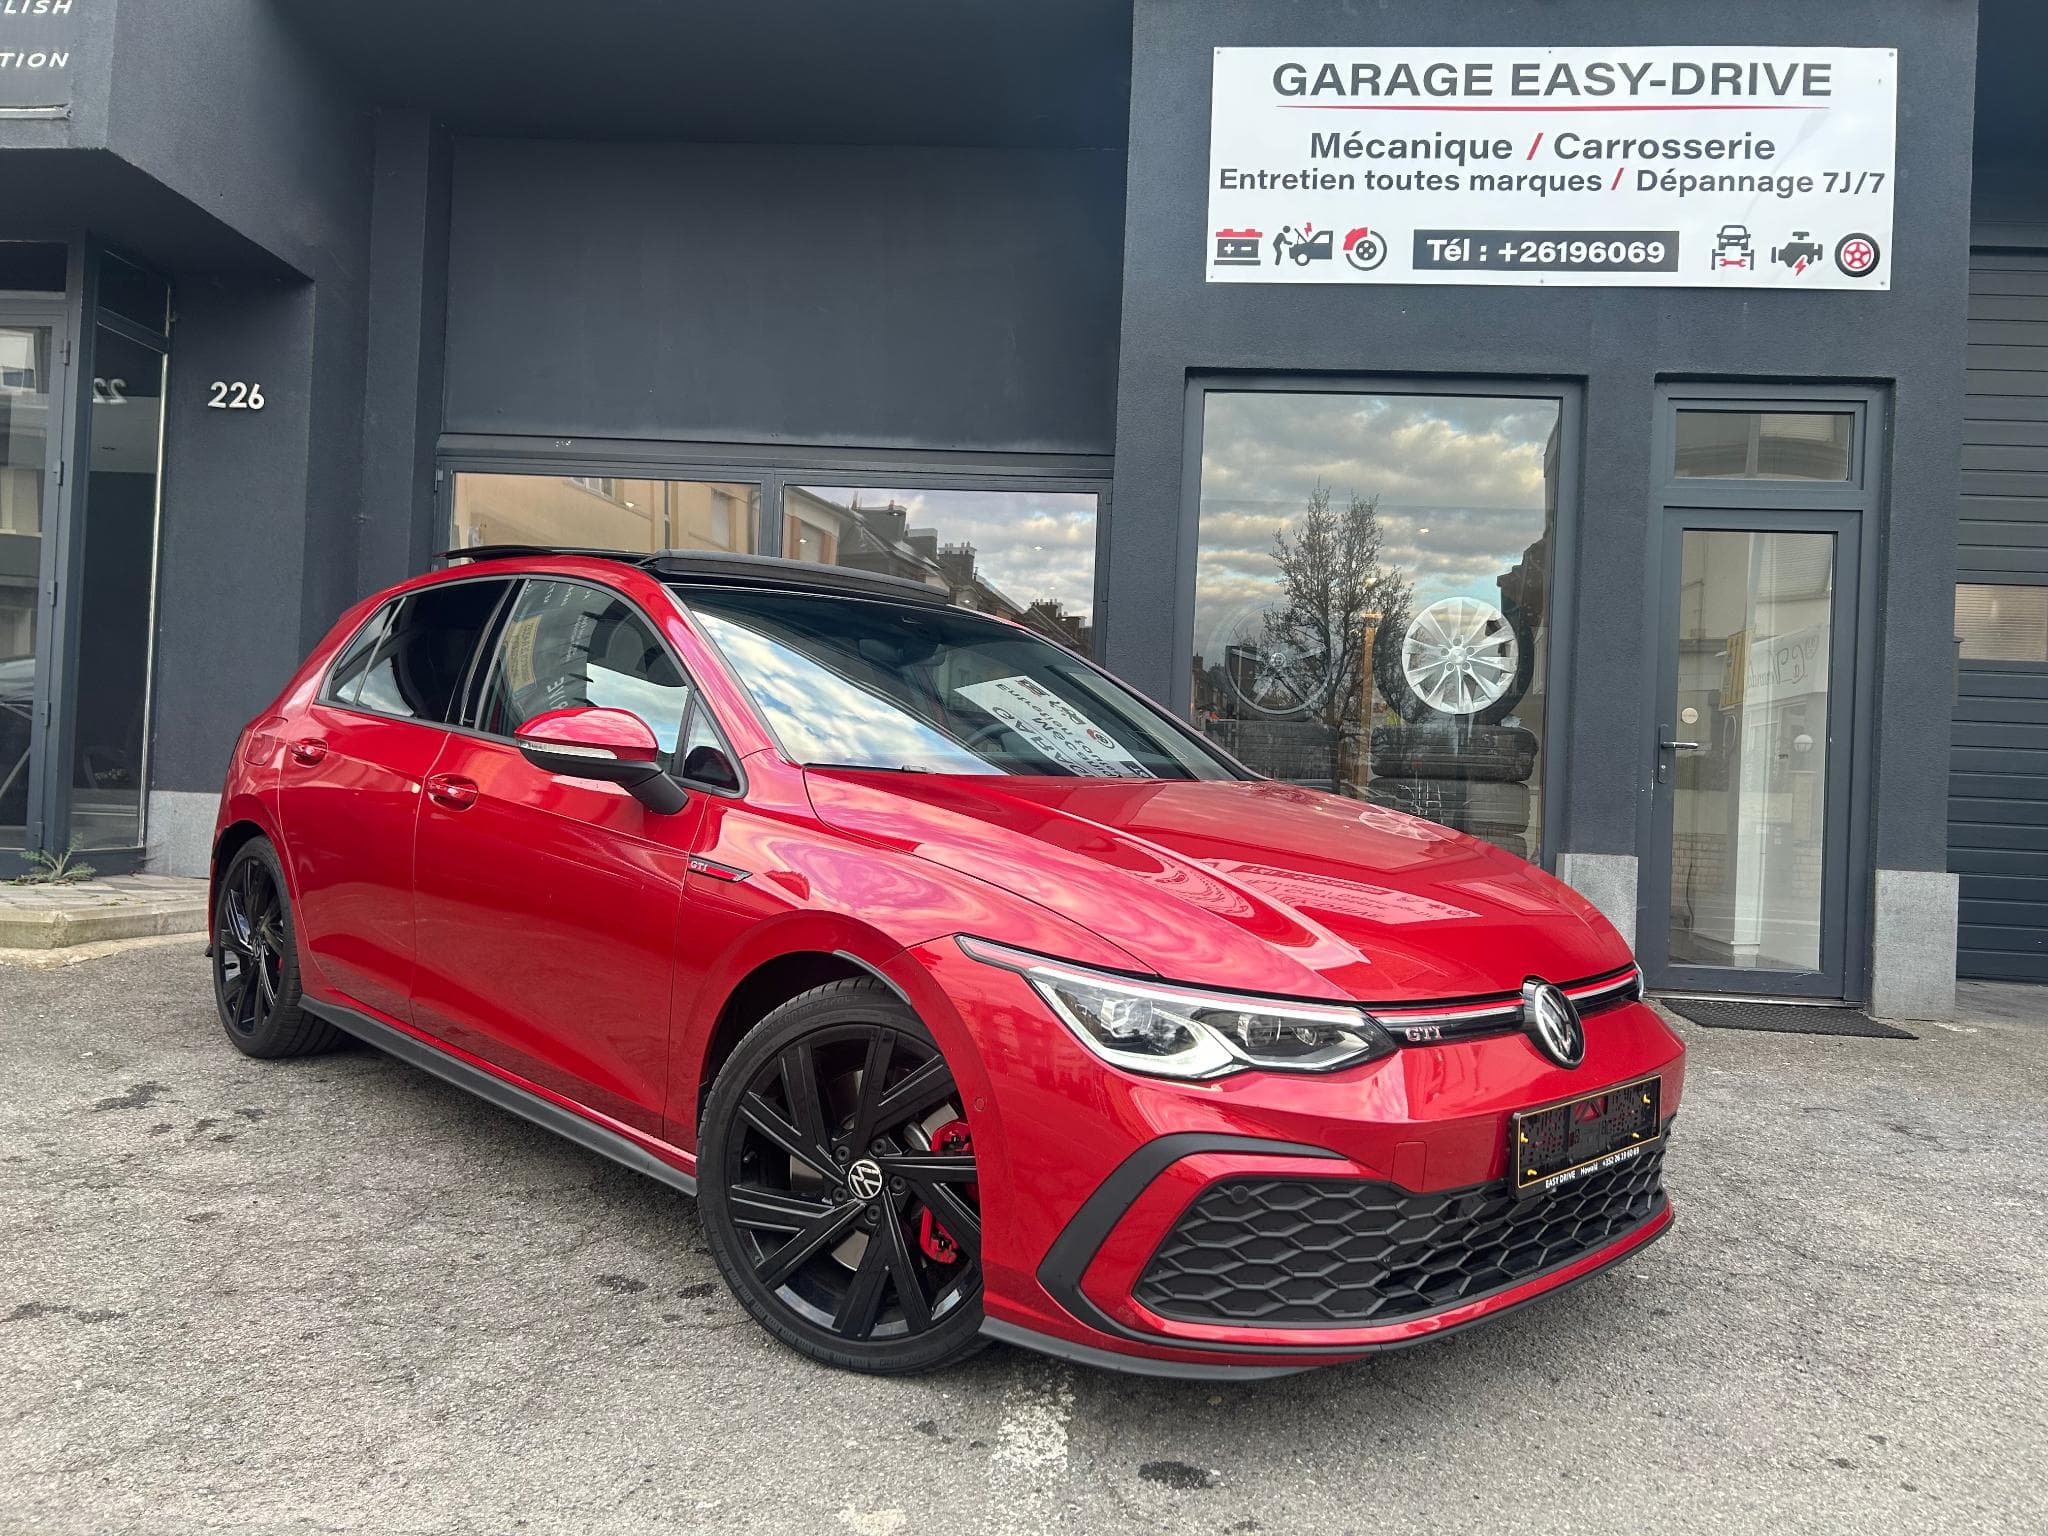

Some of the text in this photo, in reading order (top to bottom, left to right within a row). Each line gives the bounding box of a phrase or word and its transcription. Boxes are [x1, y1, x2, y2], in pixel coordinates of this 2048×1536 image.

[3, 0, 73, 15] LISH
[0, 52, 70, 68] TION
[1272, 62, 1832, 97] GARAGE EASY-DRIVE
[1310, 130, 1513, 167] Mécanique
[1554, 131, 1776, 160] Carrosserie
[1219, 167, 1355, 190] Entretien
[1364, 169, 1460, 191] toutes
[1469, 174, 1602, 198] marques
[1636, 167, 1814, 199] Dépannage
[1822, 171, 1885, 194] 7J/7
[1426, 238, 1471, 262] Tél
[1497, 241, 1666, 264] +26196069
[207, 381, 265, 410] 226
[690, 861, 709, 872] GTI
[1405, 1025, 1442, 1042] GTI
[1560, 1170, 1576, 1183] DRIVE
